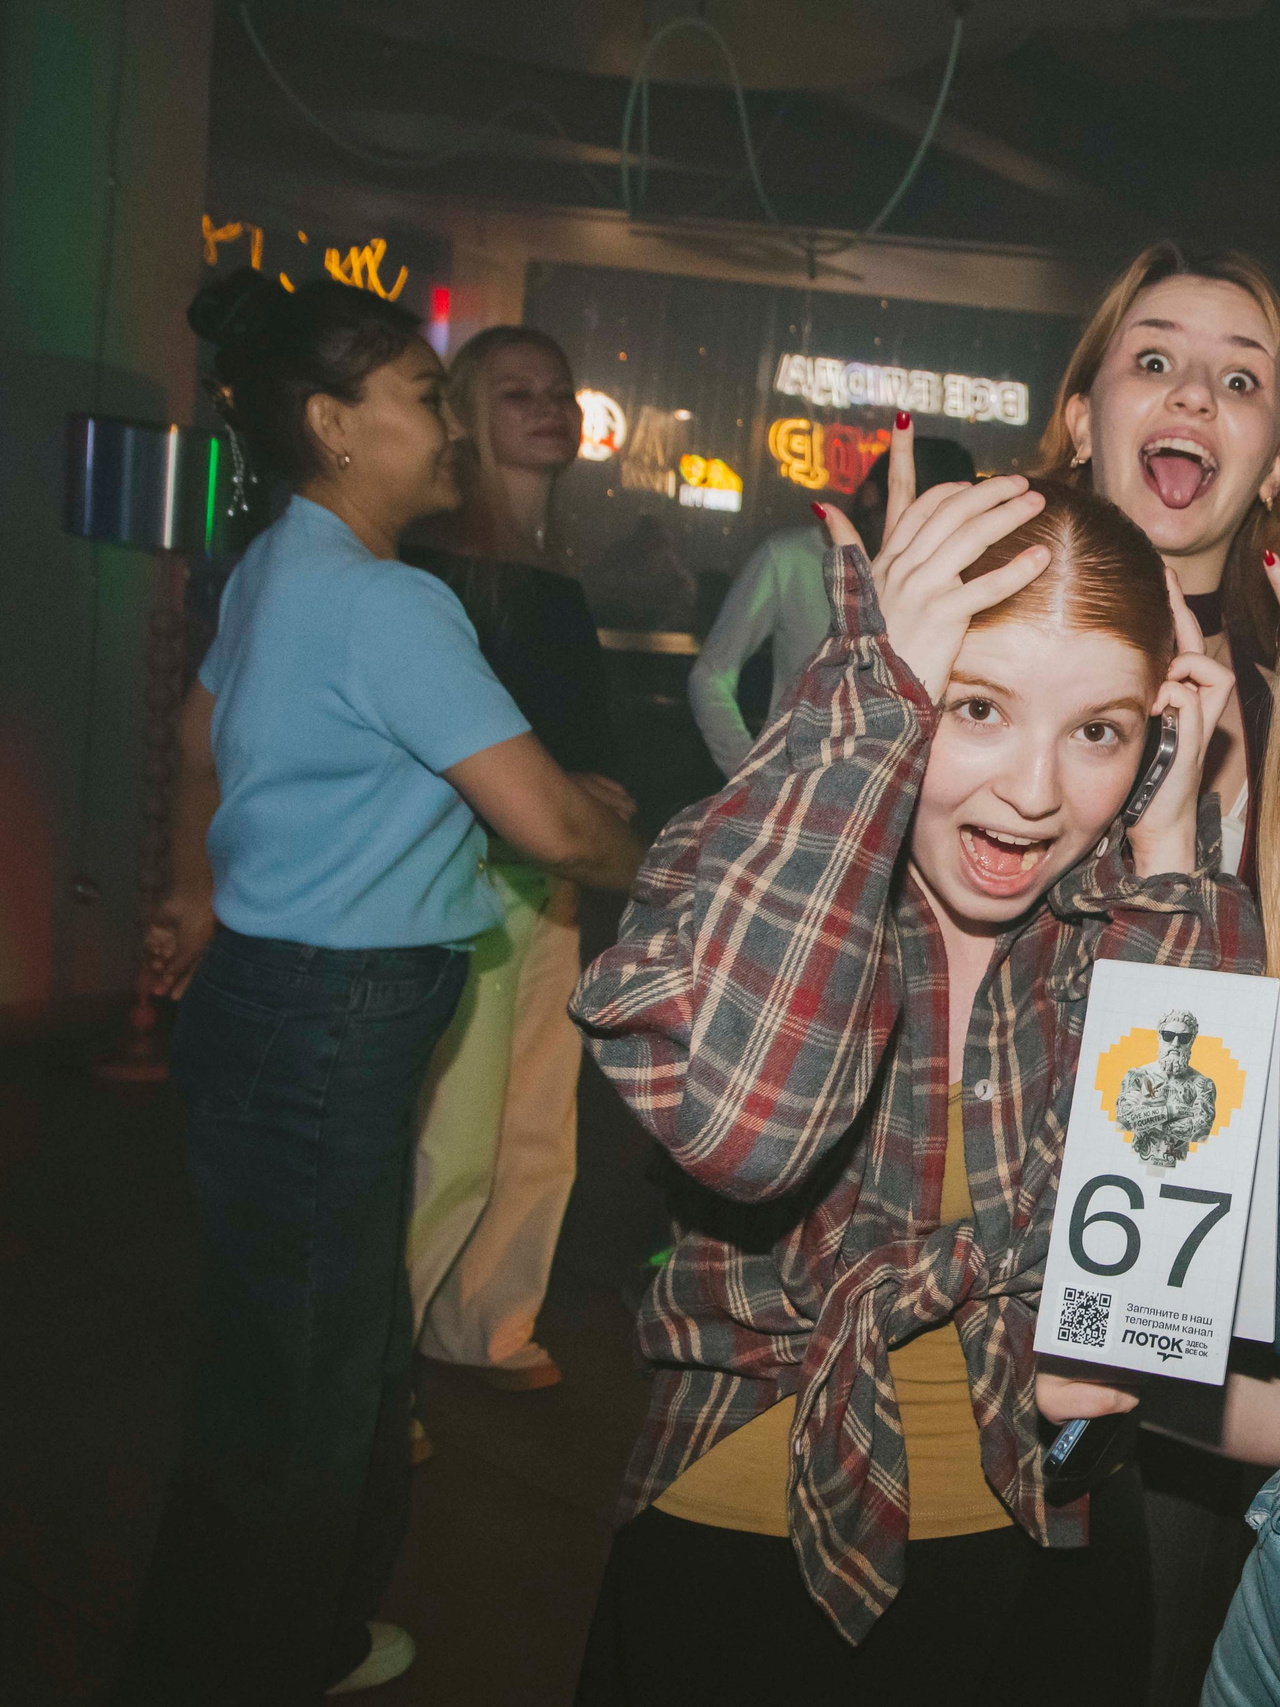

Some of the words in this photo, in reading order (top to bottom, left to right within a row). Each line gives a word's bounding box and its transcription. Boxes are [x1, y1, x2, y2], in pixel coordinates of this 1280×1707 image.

[1137, 1114, 1166, 1126] QUARTER
[1069, 1174, 1232, 1288] 67
[1126, 1303, 1180, 1320] Загляните
[1181, 1312, 1188, 1321] в
[1189, 1315, 1213, 1326] наш
[1125, 1315, 1180, 1332] телеграмм
[1181, 1324, 1214, 1338] канал
[1121, 1330, 1184, 1353] ПОТОК
[1184, 1347, 1198, 1356] ВСЕ
[1198, 1350, 1208, 1358] ОК
[1186, 1340, 1208, 1350] ЗДЕСЬ
